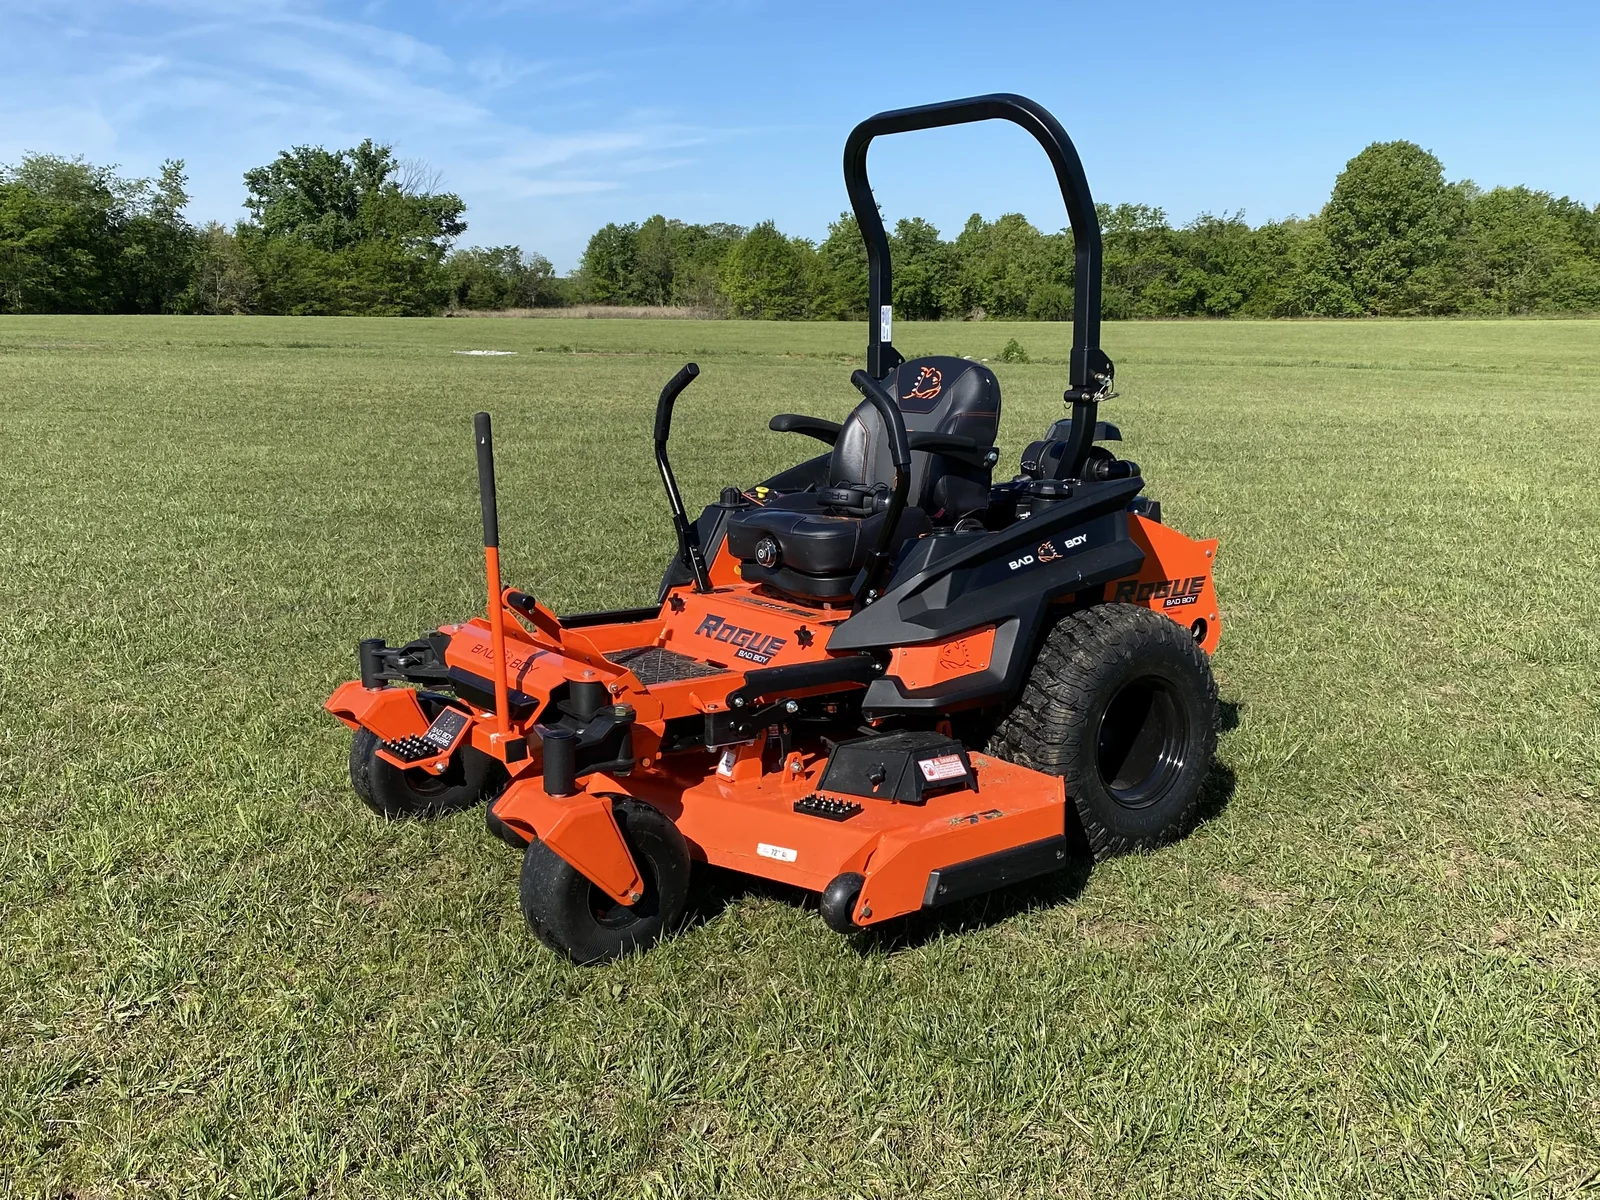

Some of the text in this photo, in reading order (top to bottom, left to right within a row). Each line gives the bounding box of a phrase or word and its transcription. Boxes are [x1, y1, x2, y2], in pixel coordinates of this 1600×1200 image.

[1008, 533, 1087, 570] BAD BOY
[1113, 576, 1207, 603] ROGUE
[1166, 598, 1181, 606] BAD
[694, 613, 788, 657] ROGUE
[738, 650, 769, 663] BAD BOY
[509, 658, 540, 674] BOY
[427, 732, 450, 747] MOWERS
[431, 726, 454, 740] BAD BOY
